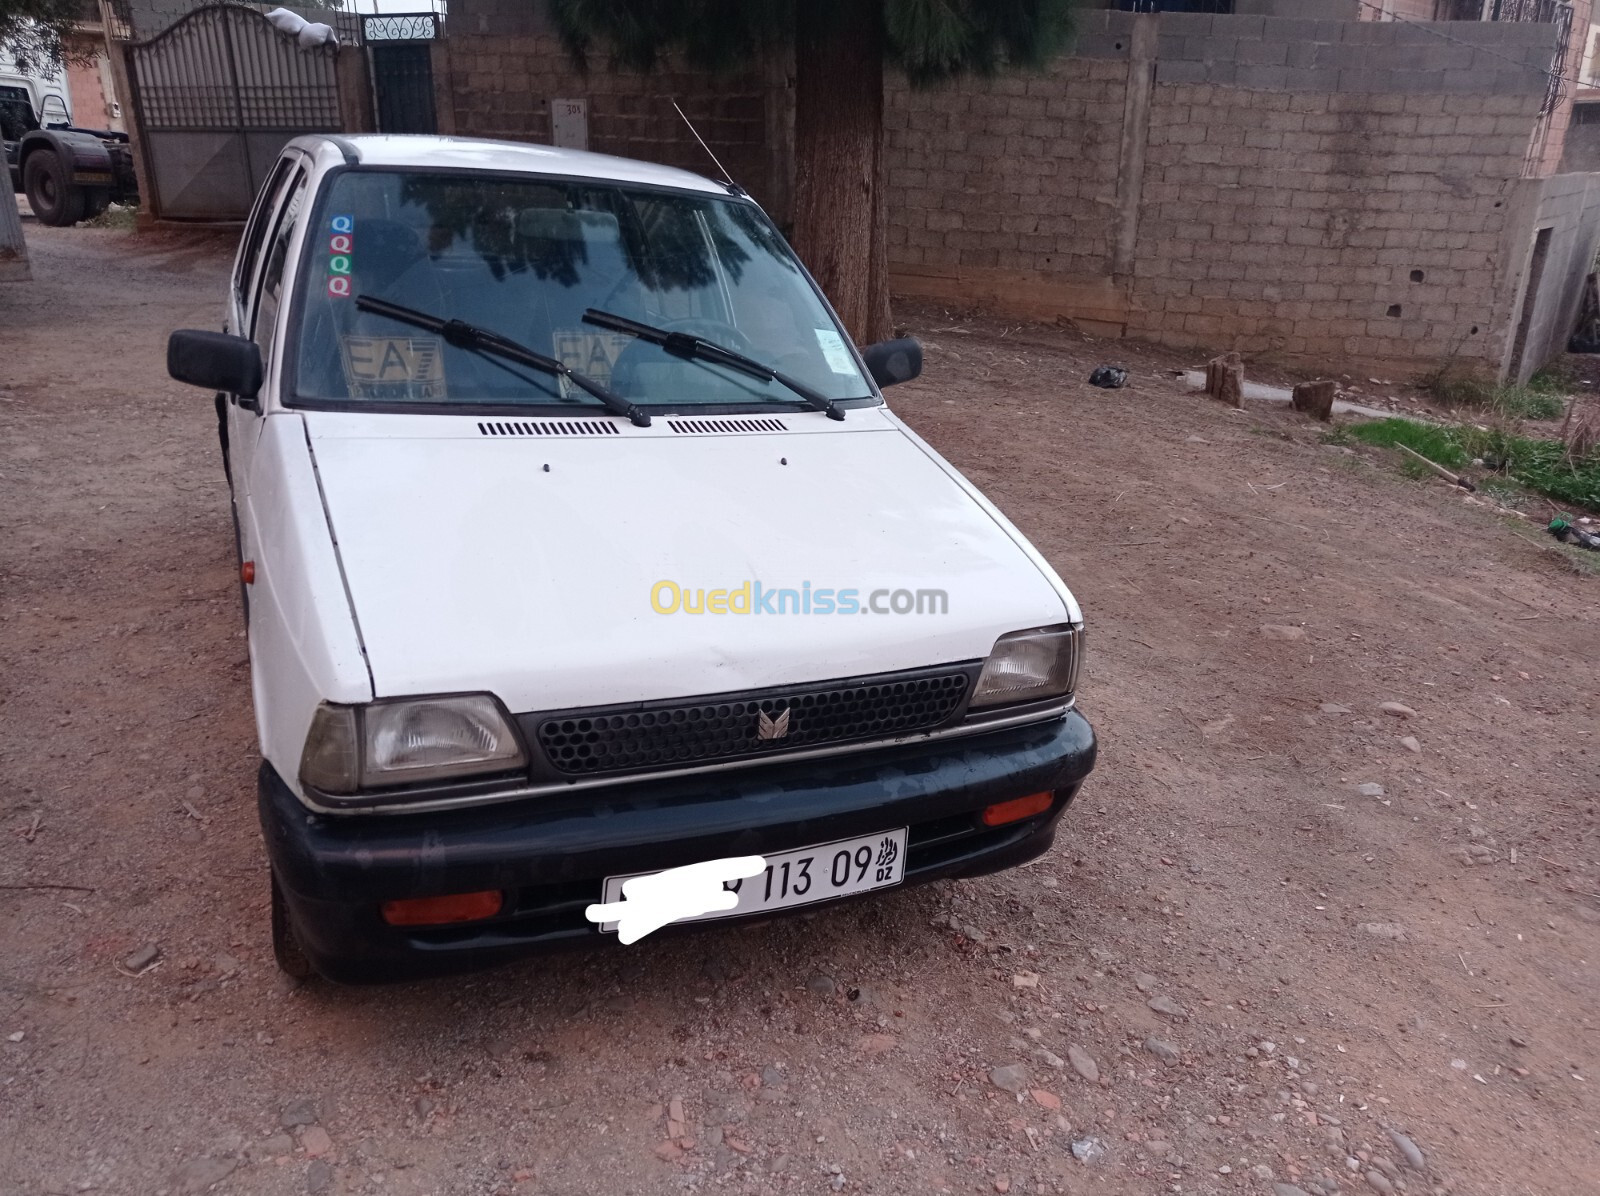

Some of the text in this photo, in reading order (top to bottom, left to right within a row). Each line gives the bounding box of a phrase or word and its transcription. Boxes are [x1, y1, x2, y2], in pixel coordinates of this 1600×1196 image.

[332, 216, 350, 233] Q
[331, 236, 351, 253] Q
[330, 256, 350, 274] Q
[329, 277, 349, 296] Q
[764, 857, 815, 903] 113
[831, 846, 872, 887] 09
[876, 866, 893, 882] DZ
